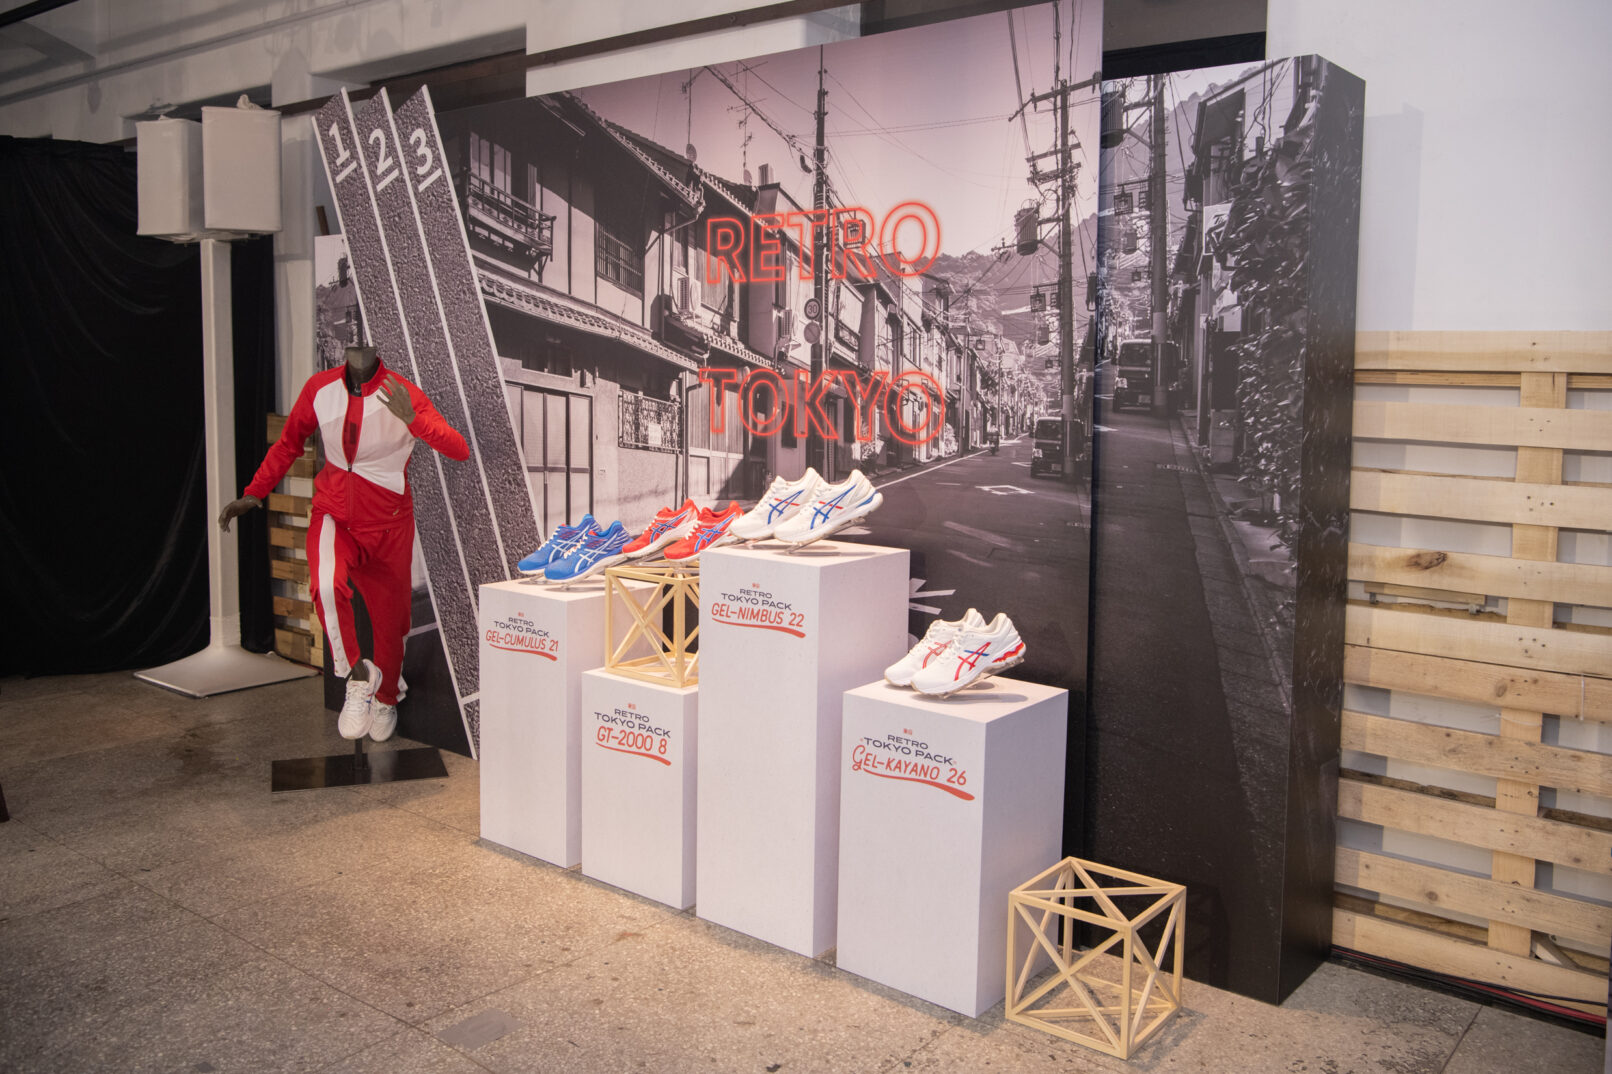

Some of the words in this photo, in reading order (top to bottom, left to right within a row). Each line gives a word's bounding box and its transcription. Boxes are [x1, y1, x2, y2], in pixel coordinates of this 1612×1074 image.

[329, 122, 350, 166] 1
[368, 128, 393, 176] 2
[409, 128, 433, 175] 3
[706, 201, 941, 284] RETRO
[807, 304, 818, 314] 30
[698, 368, 945, 445] TOKYO
[721, 592, 759, 605] TOKYO
[761, 599, 792, 611] PACK
[739, 588, 773, 599] RETRO
[508, 617, 534, 627] RETRO
[711, 602, 784, 625] GEL-NIMBUS
[788, 612, 805, 627] 22
[485, 629, 547, 650] GEL-CUMULUS
[549, 639, 559, 652] 21
[494, 620, 524, 632] TOKYO
[525, 627, 549, 638] PACK
[594, 711, 635, 729] TOKYO
[638, 723, 671, 739] PACK
[614, 708, 650, 723] RETRO
[597, 725, 654, 751] GT-2000
[658, 738, 668, 755] 8
[863, 737, 912, 755] TOKYO
[915, 749, 953, 766] PACK
[887, 734, 929, 750] RETRO
[852, 744, 940, 781] GEL-KAYANO
[946, 767, 967, 786] 26
